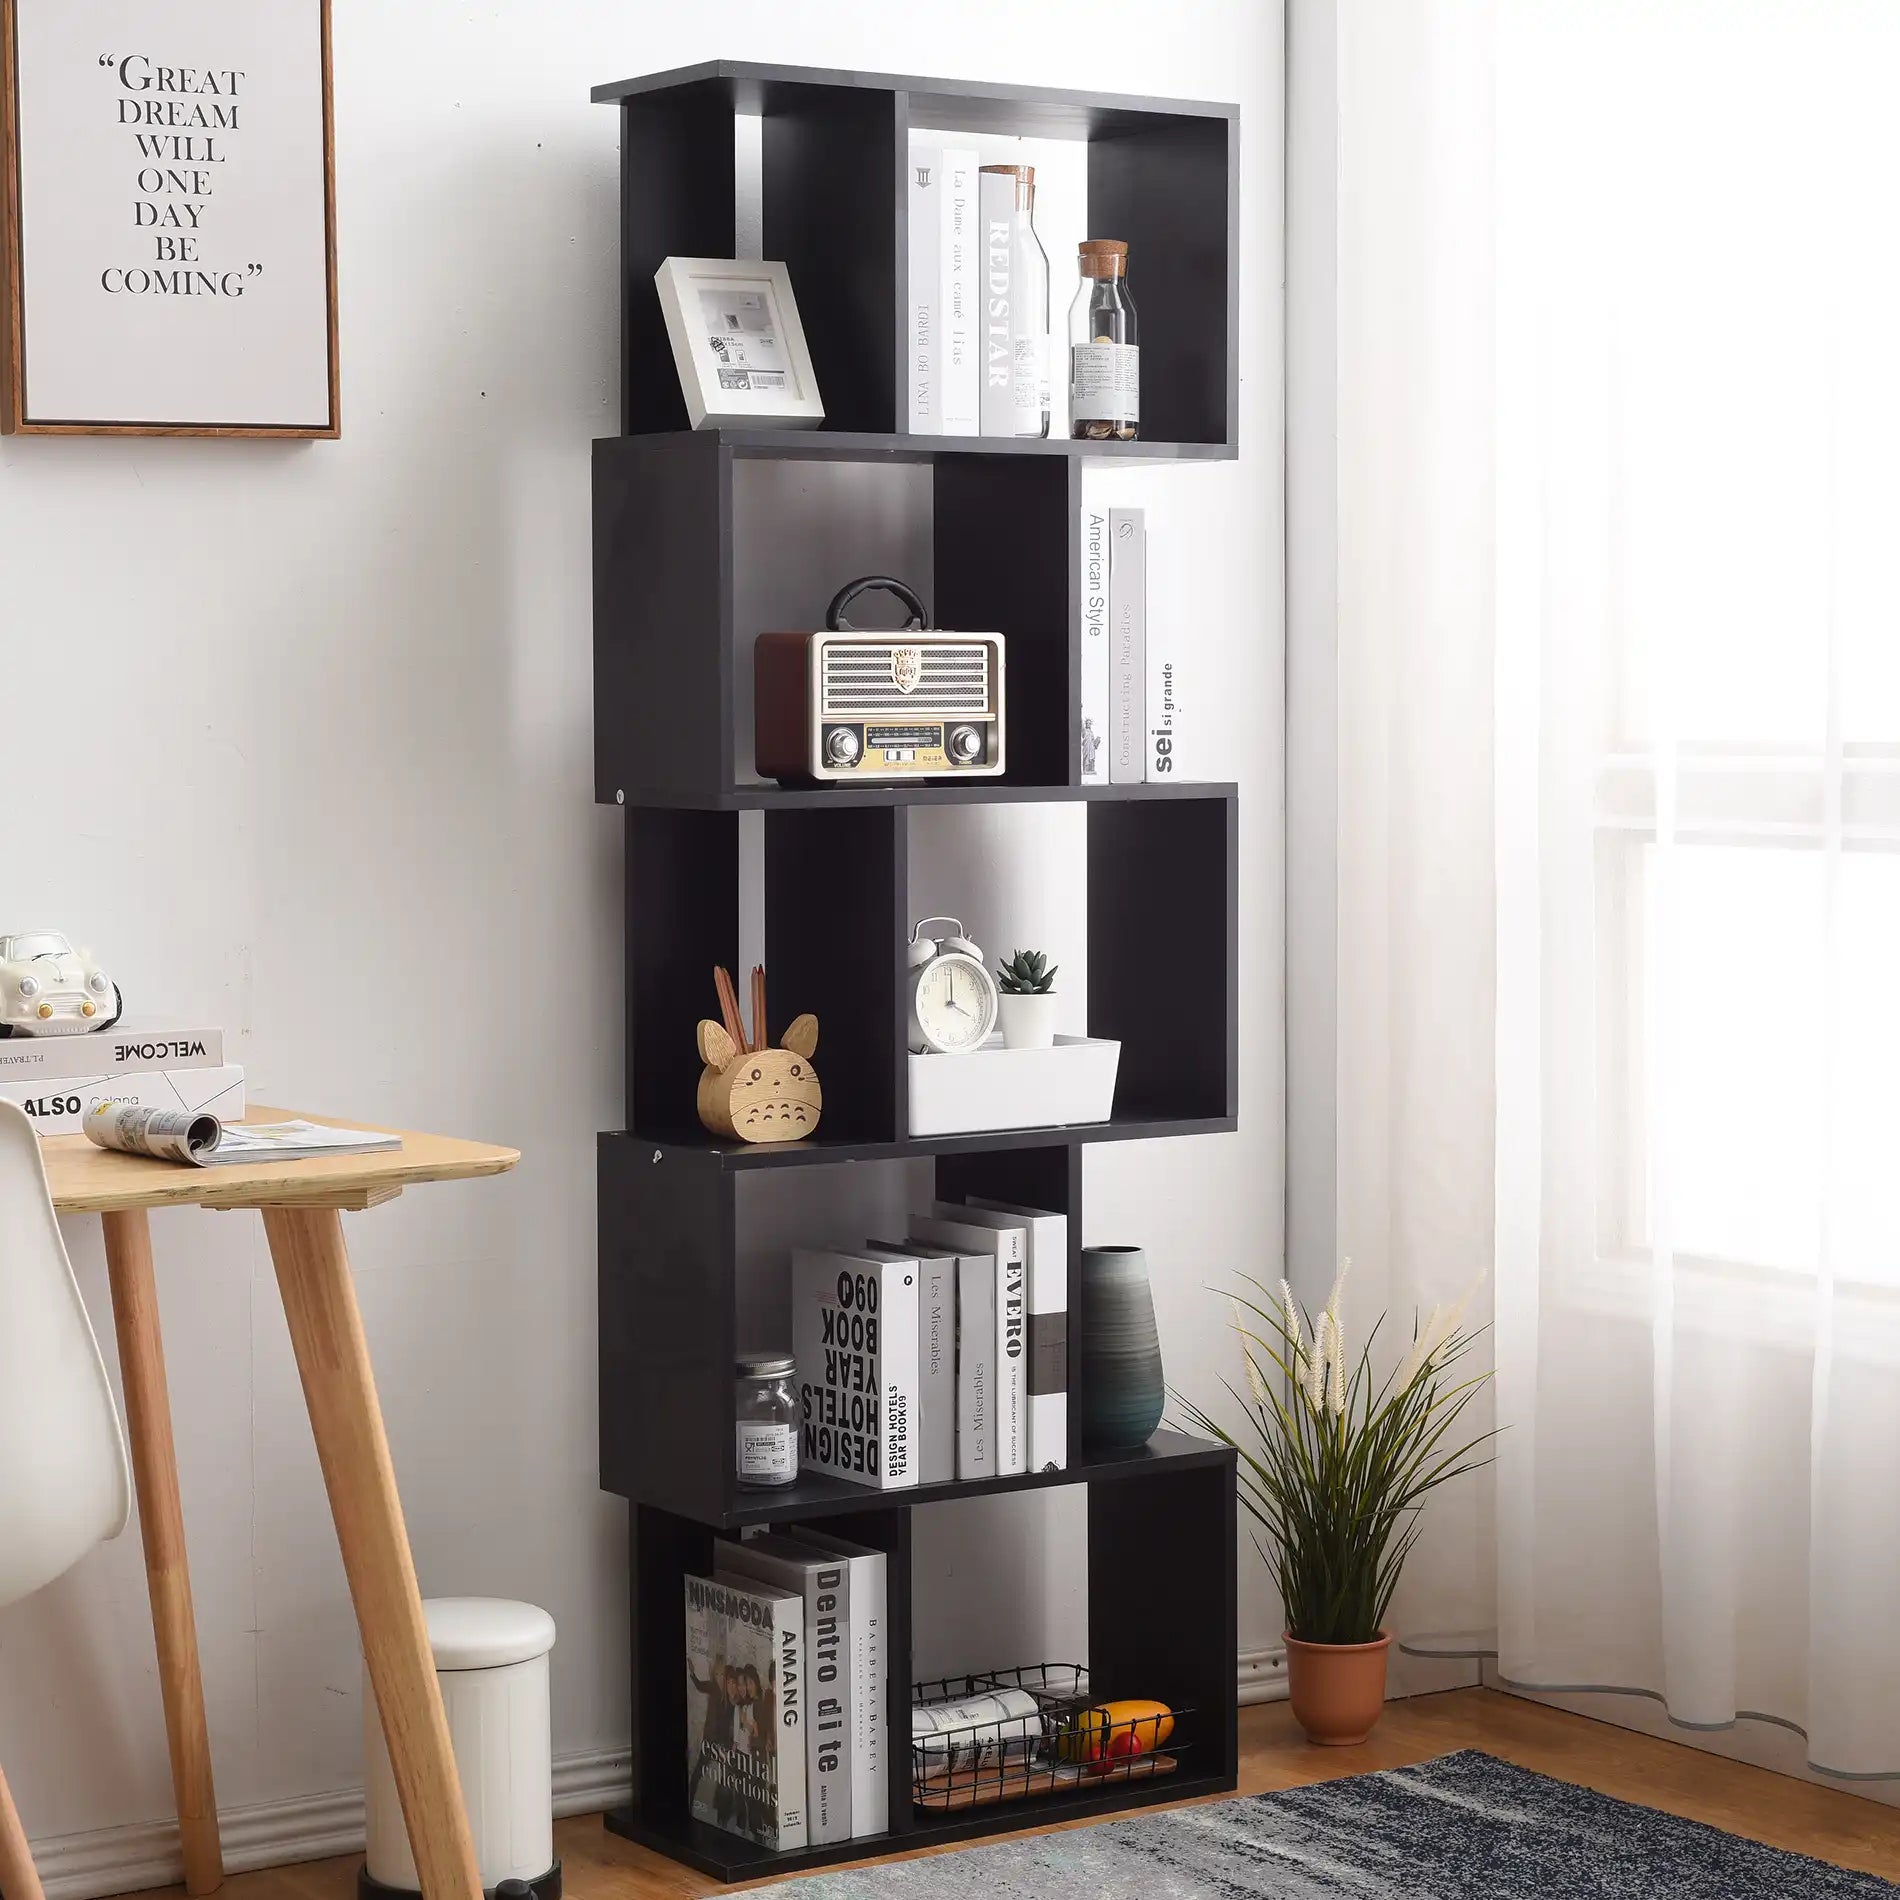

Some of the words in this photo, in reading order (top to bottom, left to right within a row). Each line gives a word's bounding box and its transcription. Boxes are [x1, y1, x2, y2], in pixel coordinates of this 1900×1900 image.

[116, 98, 240, 130] DREAM
[133, 133, 226, 163] WILL
[137, 167, 212, 195] ONE
[953, 169, 966, 189] La
[133, 201, 206, 228] DAY
[953, 199, 966, 235] Dame
[155, 236, 199, 262] BE
[953, 243, 963, 272] aux
[917, 304, 929, 346] BARDI
[917, 354, 929, 373] BO
[917, 381, 929, 416] LINA
[1089, 513, 1105, 591] American
[1088, 596, 1105, 637] Style
[1119, 603, 1131, 665] Paradies
[1160, 662, 1175, 711] grande
[1119, 673, 1131, 767] Constructing
[1161, 713, 1172, 727] si
[1151, 729, 1173, 773] sei
[969, 982, 975, 991] 2
[115, 1041, 207, 1061] WELCOME
[24, 1096, 81, 1117] ALSO
[931, 1275, 941, 1298] Les
[821, 1307, 878, 1355] BOOK
[930, 1306, 941, 1375] Miserables
[825, 1348, 878, 1396] YEAR
[801, 1382, 878, 1436] HOTELS
[973, 1362, 984, 1431] Miserables
[1011, 1426, 1017, 1434] OF
[804, 1424, 878, 1477] DESIGN
[889, 1435, 898, 1477] DESIGN
[898, 1445, 907, 1476] YEAR
[974, 1441, 984, 1462] Les
[816, 1568, 841, 1683] Dentro
[782, 1630, 798, 1728] AMANG
[817, 1698, 842, 1731] di
[702, 1737, 777, 1785] essential
[817, 1741, 842, 1773] te
[702, 1762, 778, 1806] collections
